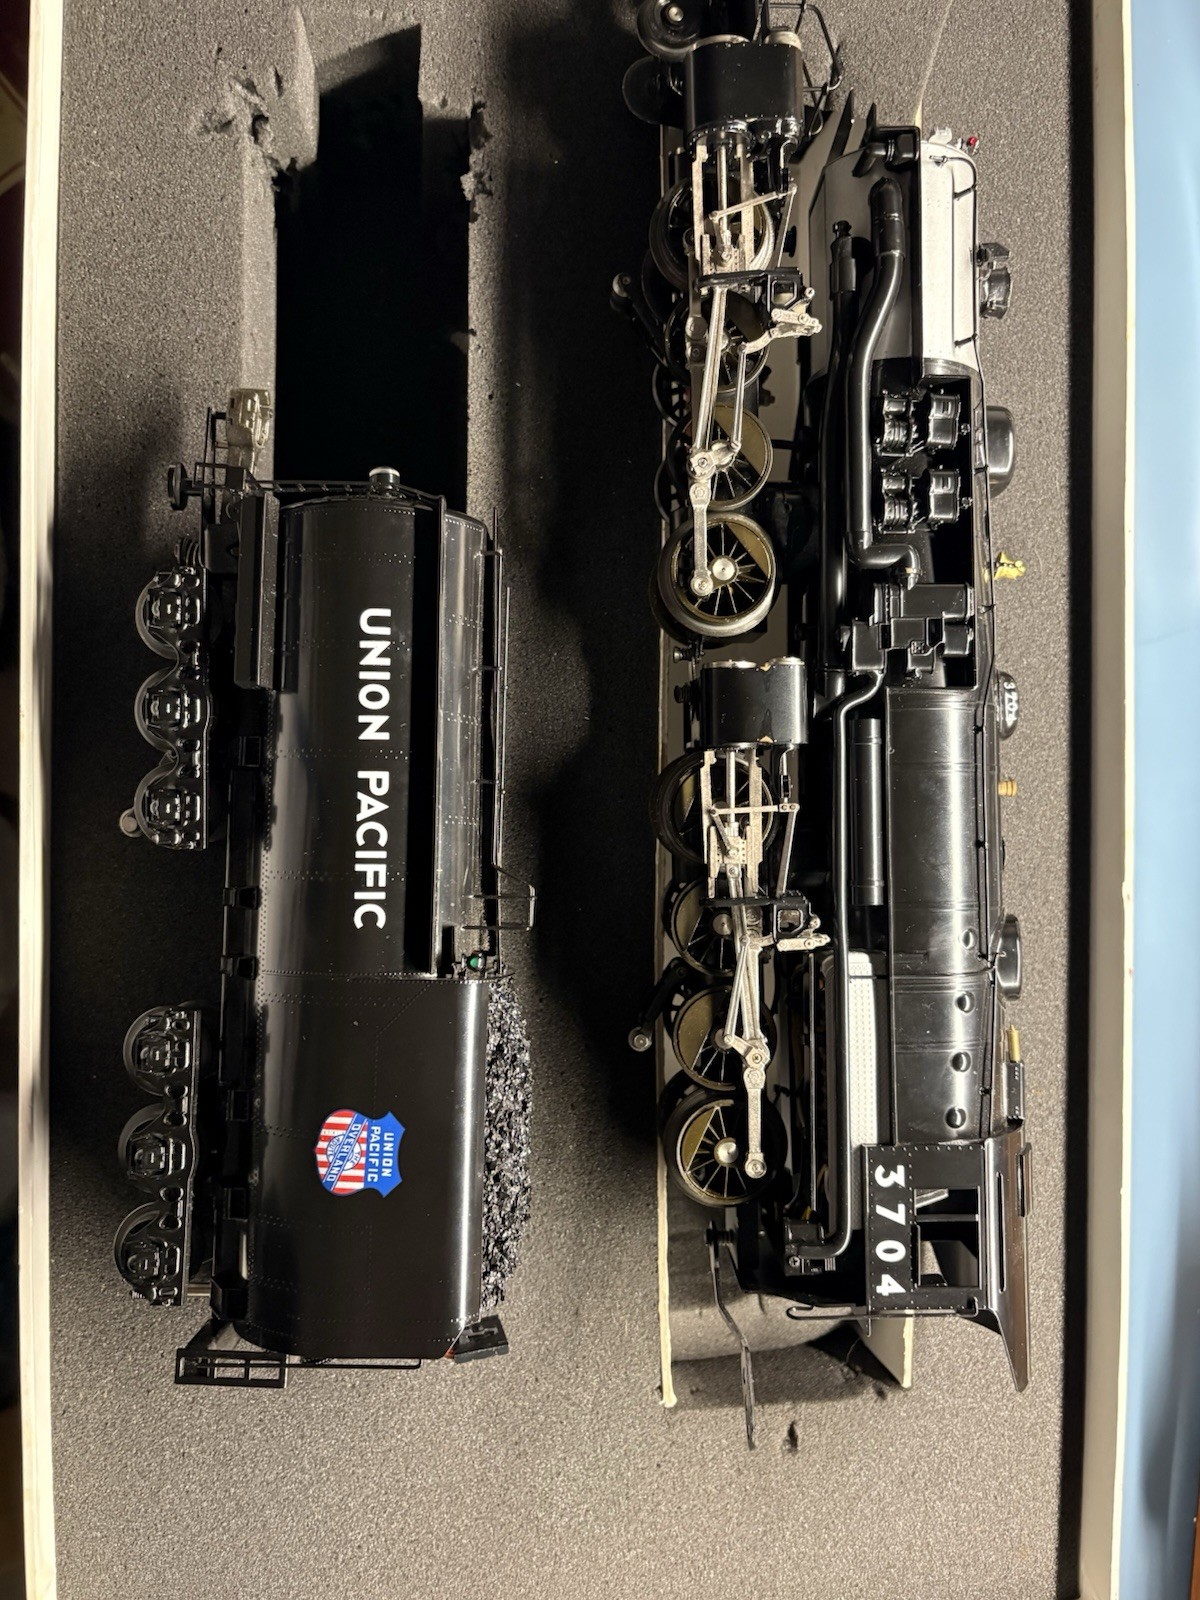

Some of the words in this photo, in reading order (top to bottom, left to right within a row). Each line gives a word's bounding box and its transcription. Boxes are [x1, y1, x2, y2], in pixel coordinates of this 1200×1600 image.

[358, 608, 392, 741] UNION
[353, 771, 390, 930] PACIFIC
[326, 1123, 362, 1182] OVERLAND
[367, 1126, 382, 1182] PACIFIC
[381, 1132, 395, 1177] UNION
[874, 1164, 907, 1296] 3704
